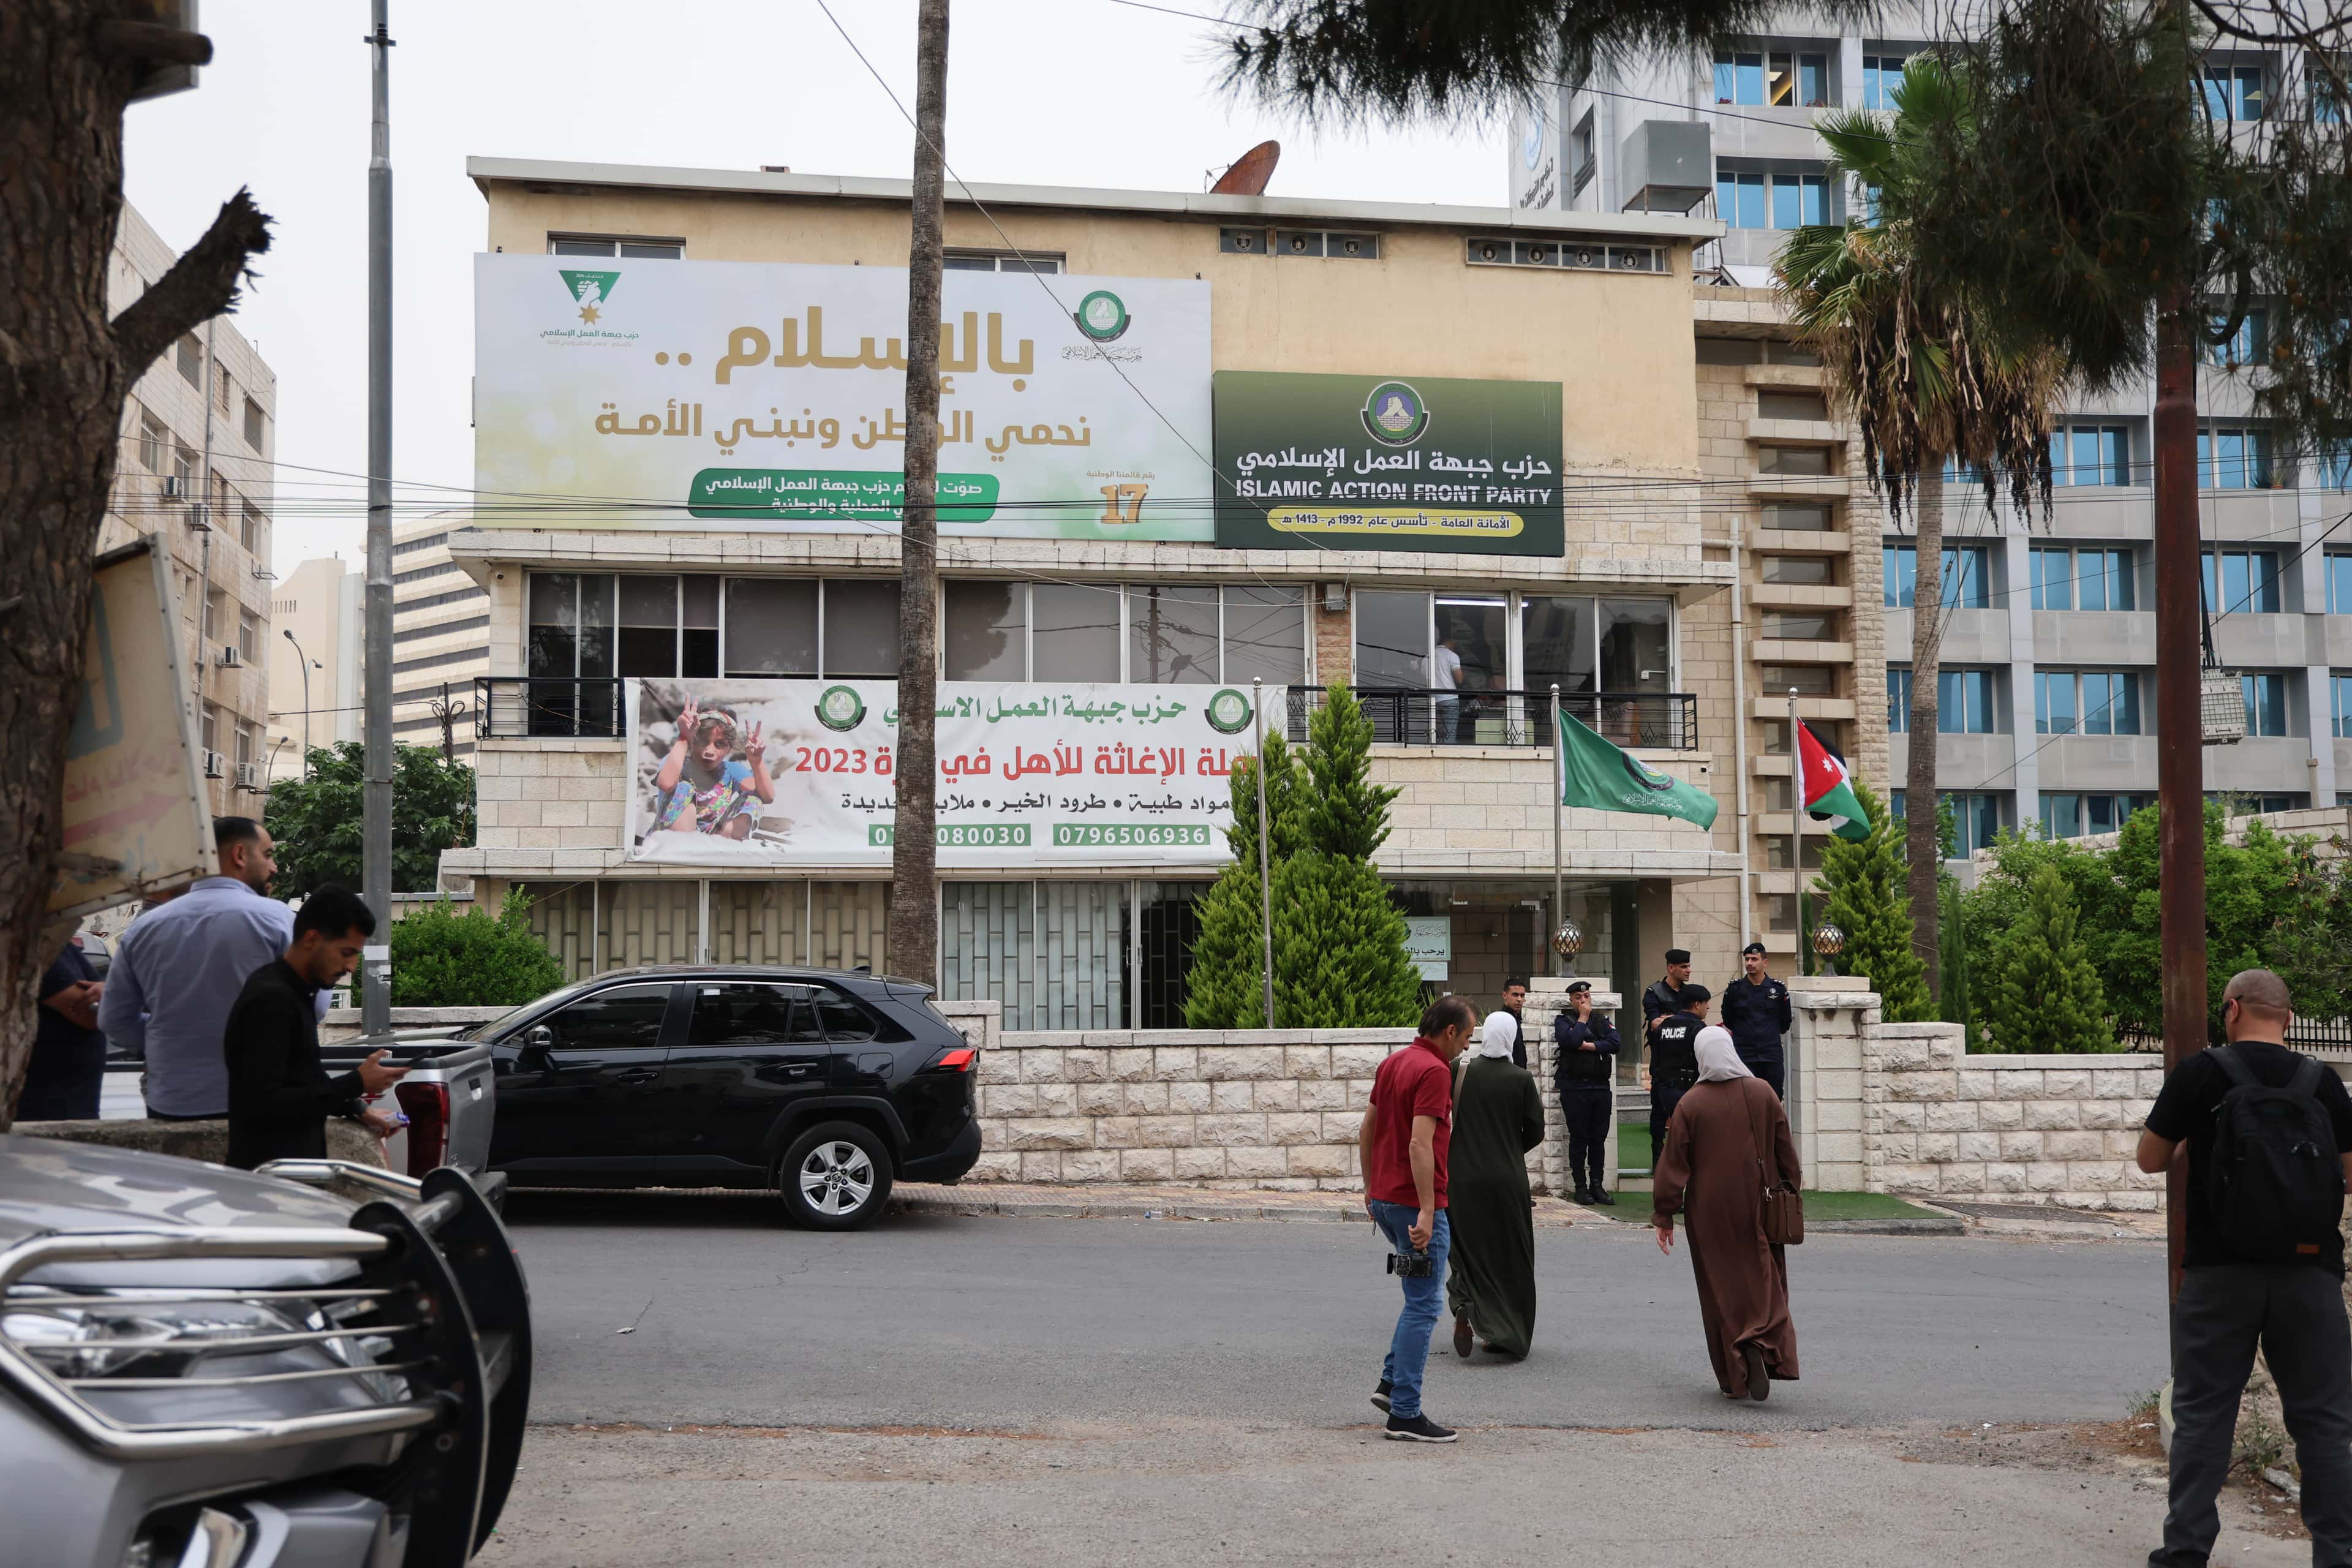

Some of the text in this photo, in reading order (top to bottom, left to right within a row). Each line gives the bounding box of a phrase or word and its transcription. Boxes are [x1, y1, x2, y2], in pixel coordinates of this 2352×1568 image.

[577, 330, 599, 338] العمل
[601, 330, 622, 339] جبهة
[624, 331, 639, 340] حزب
[594, 399, 702, 437] الأمة
[714, 407, 839, 456] ونبني
[985, 417, 1090, 462] نحمي
[1236, 447, 1551, 480] حزب جبهة العمل الإسلامي
[706, 476, 772, 494] الإسلامي
[775, 477, 817, 492] العمل
[821, 478, 859, 494] جبهة
[1142, 472, 1155, 480] رقم
[862, 480, 891, 495] حزب
[1236, 479, 1551, 505] ISLAMIC ACTION FRONT PARTY
[1100, 483, 1148, 524] 17
[1295, 513, 1318, 524] 1413
[1338, 514, 1363, 525] 1992
[1368, 514, 1387, 528] عام
[1390, 513, 1428, 530] تأسس
[1441, 515, 1473, 529] العامة
[1476, 515, 1510, 529] الأمانة
[883, 696, 980, 728] الاسي
[986, 695, 1057, 724] العمل
[1061, 694, 1126, 724] جبهة
[1132, 695, 1186, 725] حزب
[796, 747, 867, 774] 2023
[941, 747, 990, 784] في
[1003, 739, 1082, 780] للأهل
[1095, 741, 1185, 785] الإغاثة
[1197, 748, 1258, 776] ملة
[935, 794, 974, 814] ملاب
[996, 792, 1051, 813] الخير
[1060, 794, 1106, 813] طرود
[1128, 793, 1183, 813] طبية
[875, 827, 1205, 845] 0080030 0796506936
[1661, 1026, 1687, 1039] POLICE
